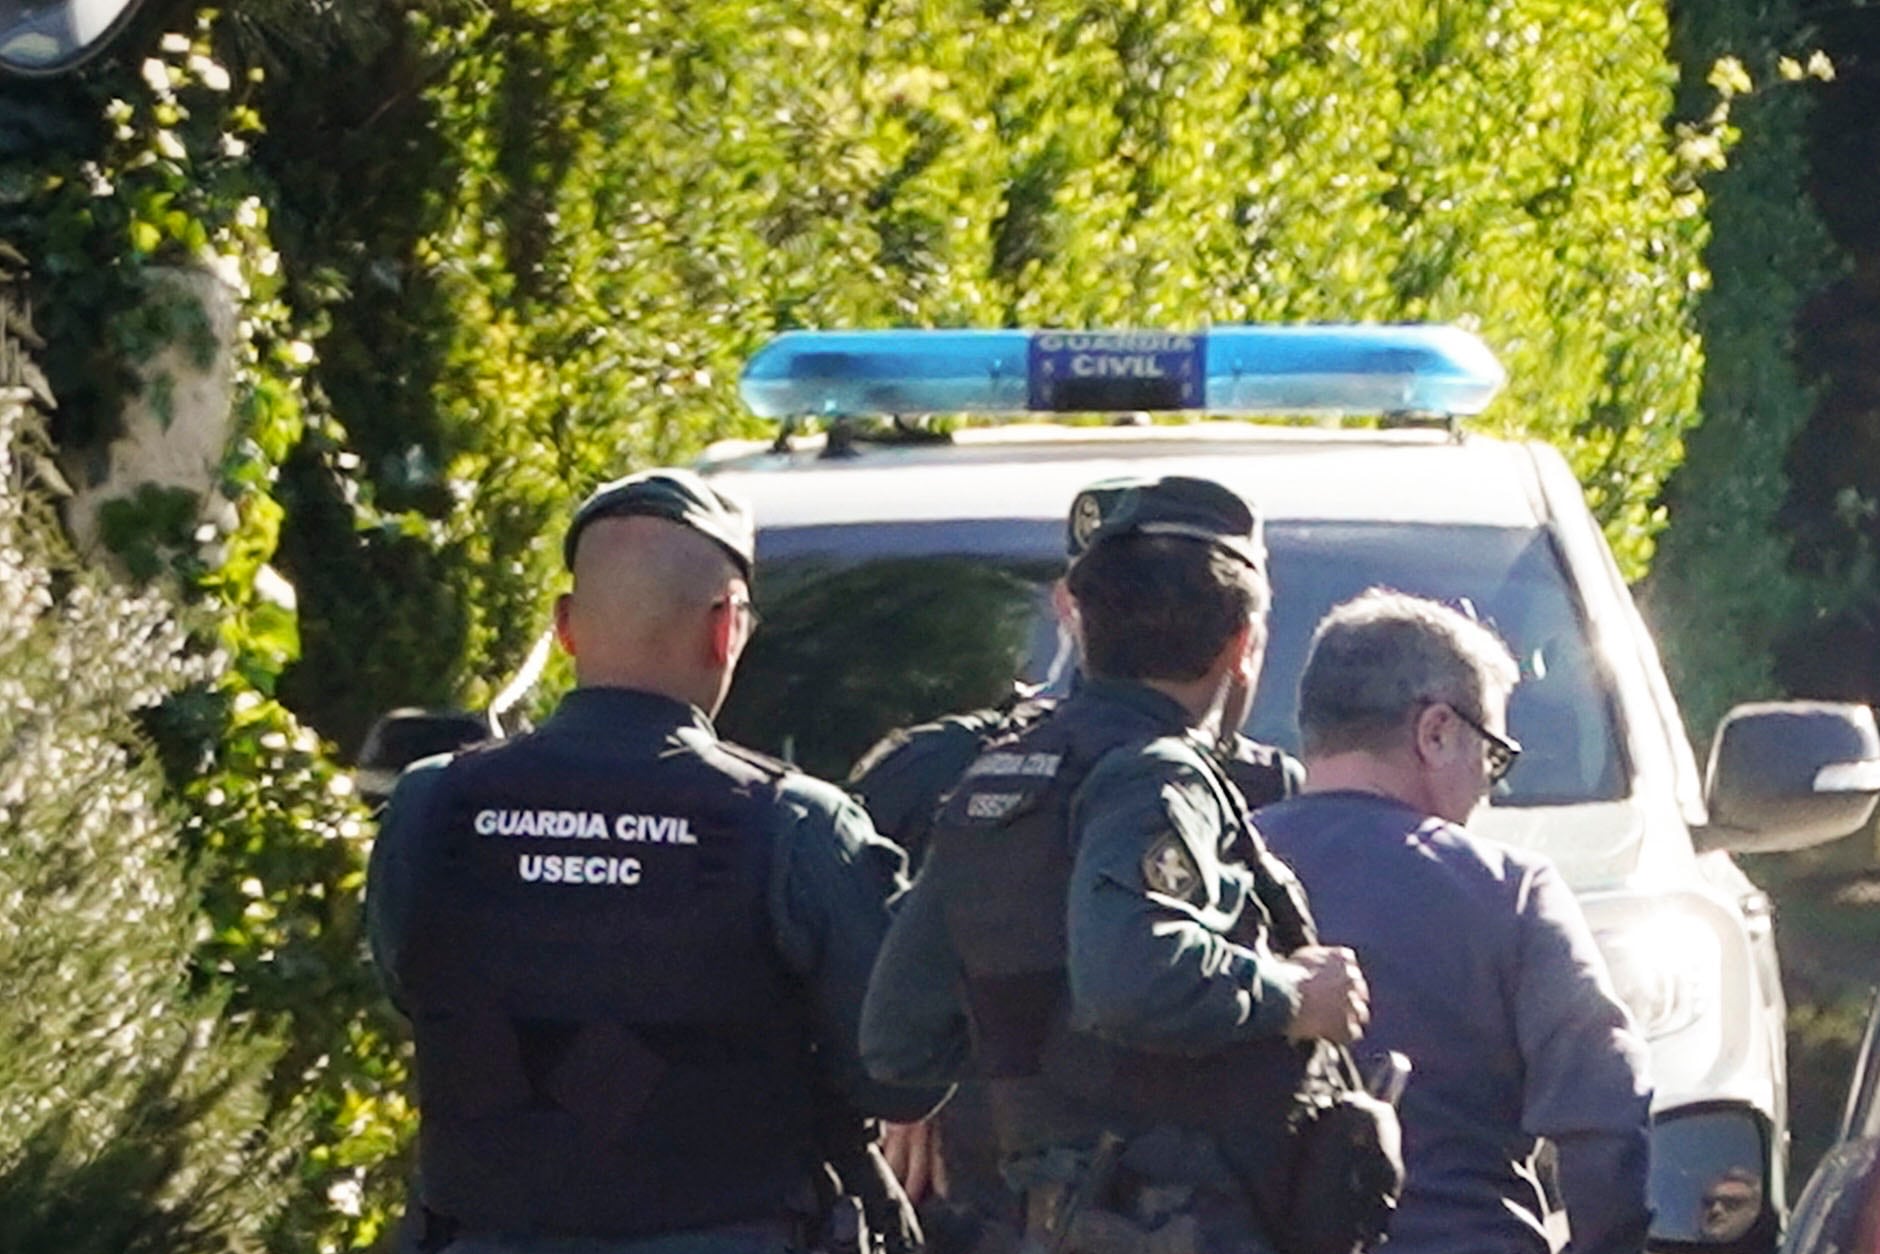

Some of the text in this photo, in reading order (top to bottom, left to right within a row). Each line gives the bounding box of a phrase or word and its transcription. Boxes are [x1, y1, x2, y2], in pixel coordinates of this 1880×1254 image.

[1071, 353, 1164, 377] CIVIL
[474, 809, 698, 844] GUARDIA CIVIL
[519, 854, 642, 885] USECIC
